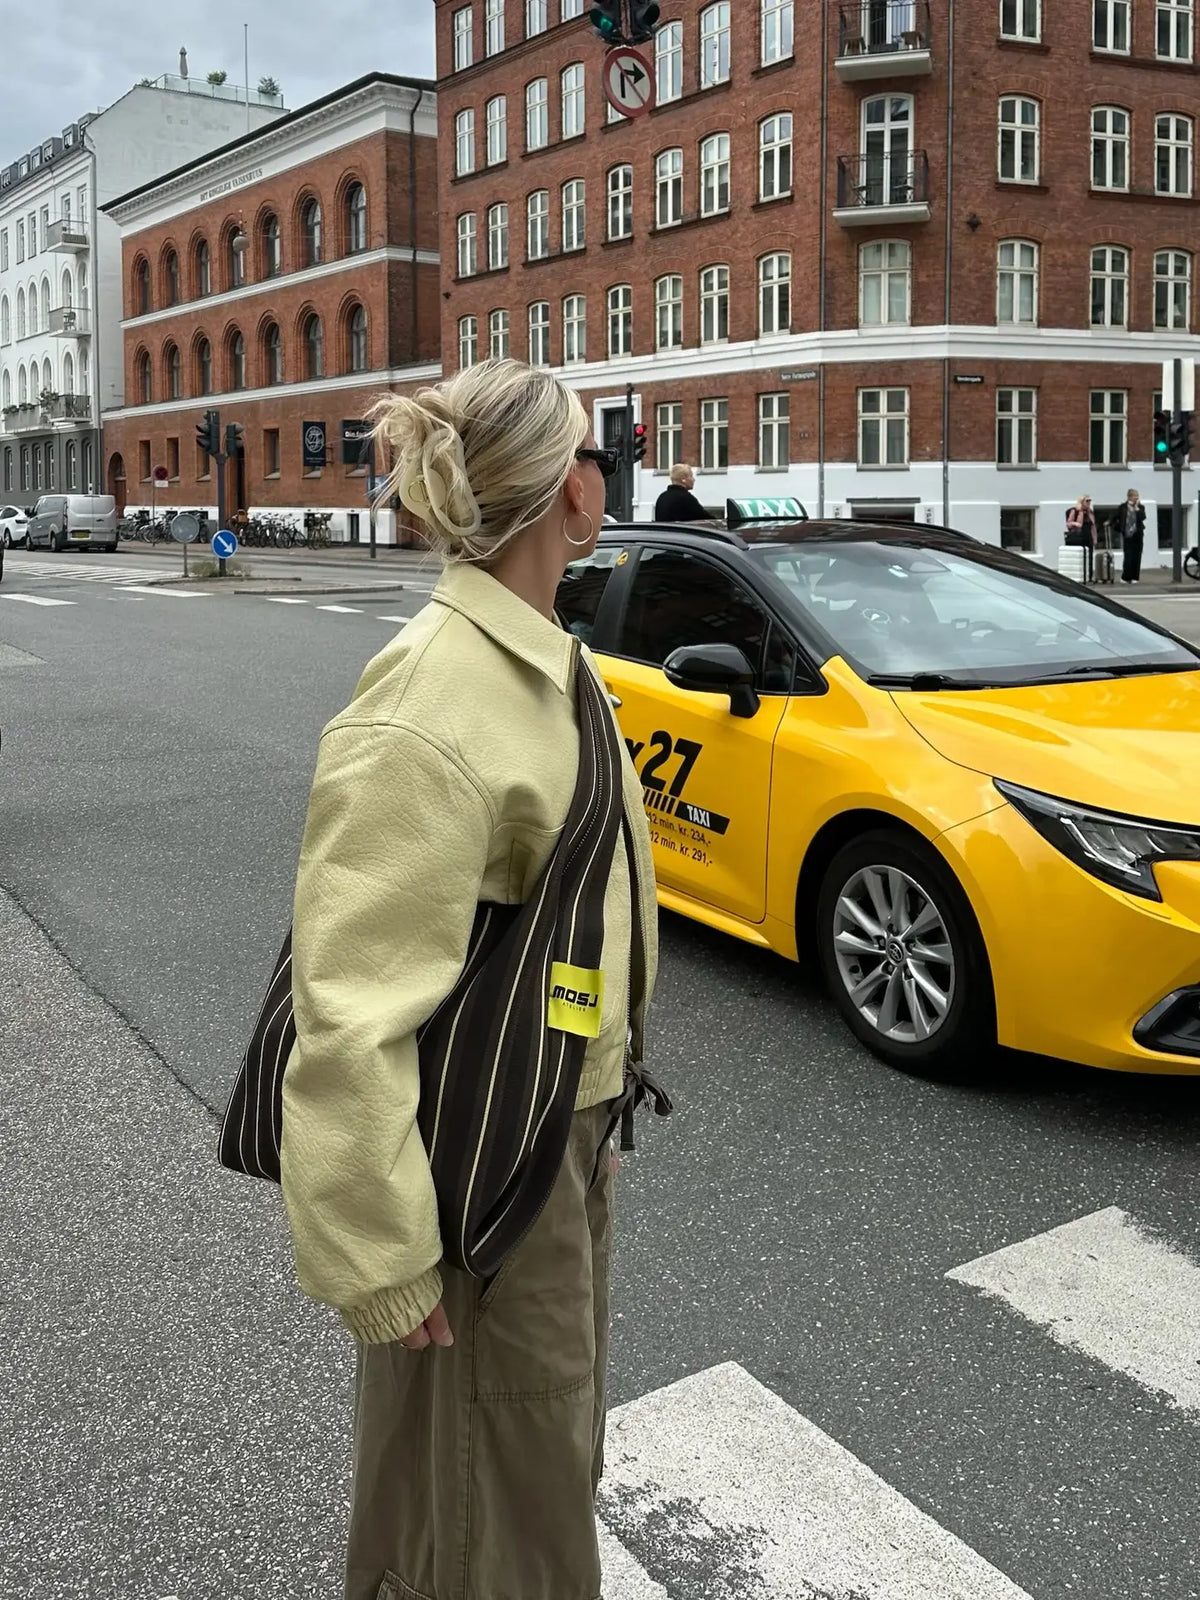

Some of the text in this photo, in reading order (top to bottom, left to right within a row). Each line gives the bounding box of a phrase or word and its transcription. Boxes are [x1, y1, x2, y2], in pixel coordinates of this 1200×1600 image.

[735, 499, 804, 518] TAXI
[686, 804, 711, 828] TAXI
[678, 823, 689, 837] kr.
[650, 830, 660, 844] 12
[660, 836, 677, 852] min.
[680, 842, 690, 857] kr.
[552, 985, 599, 1008] MOSJ
